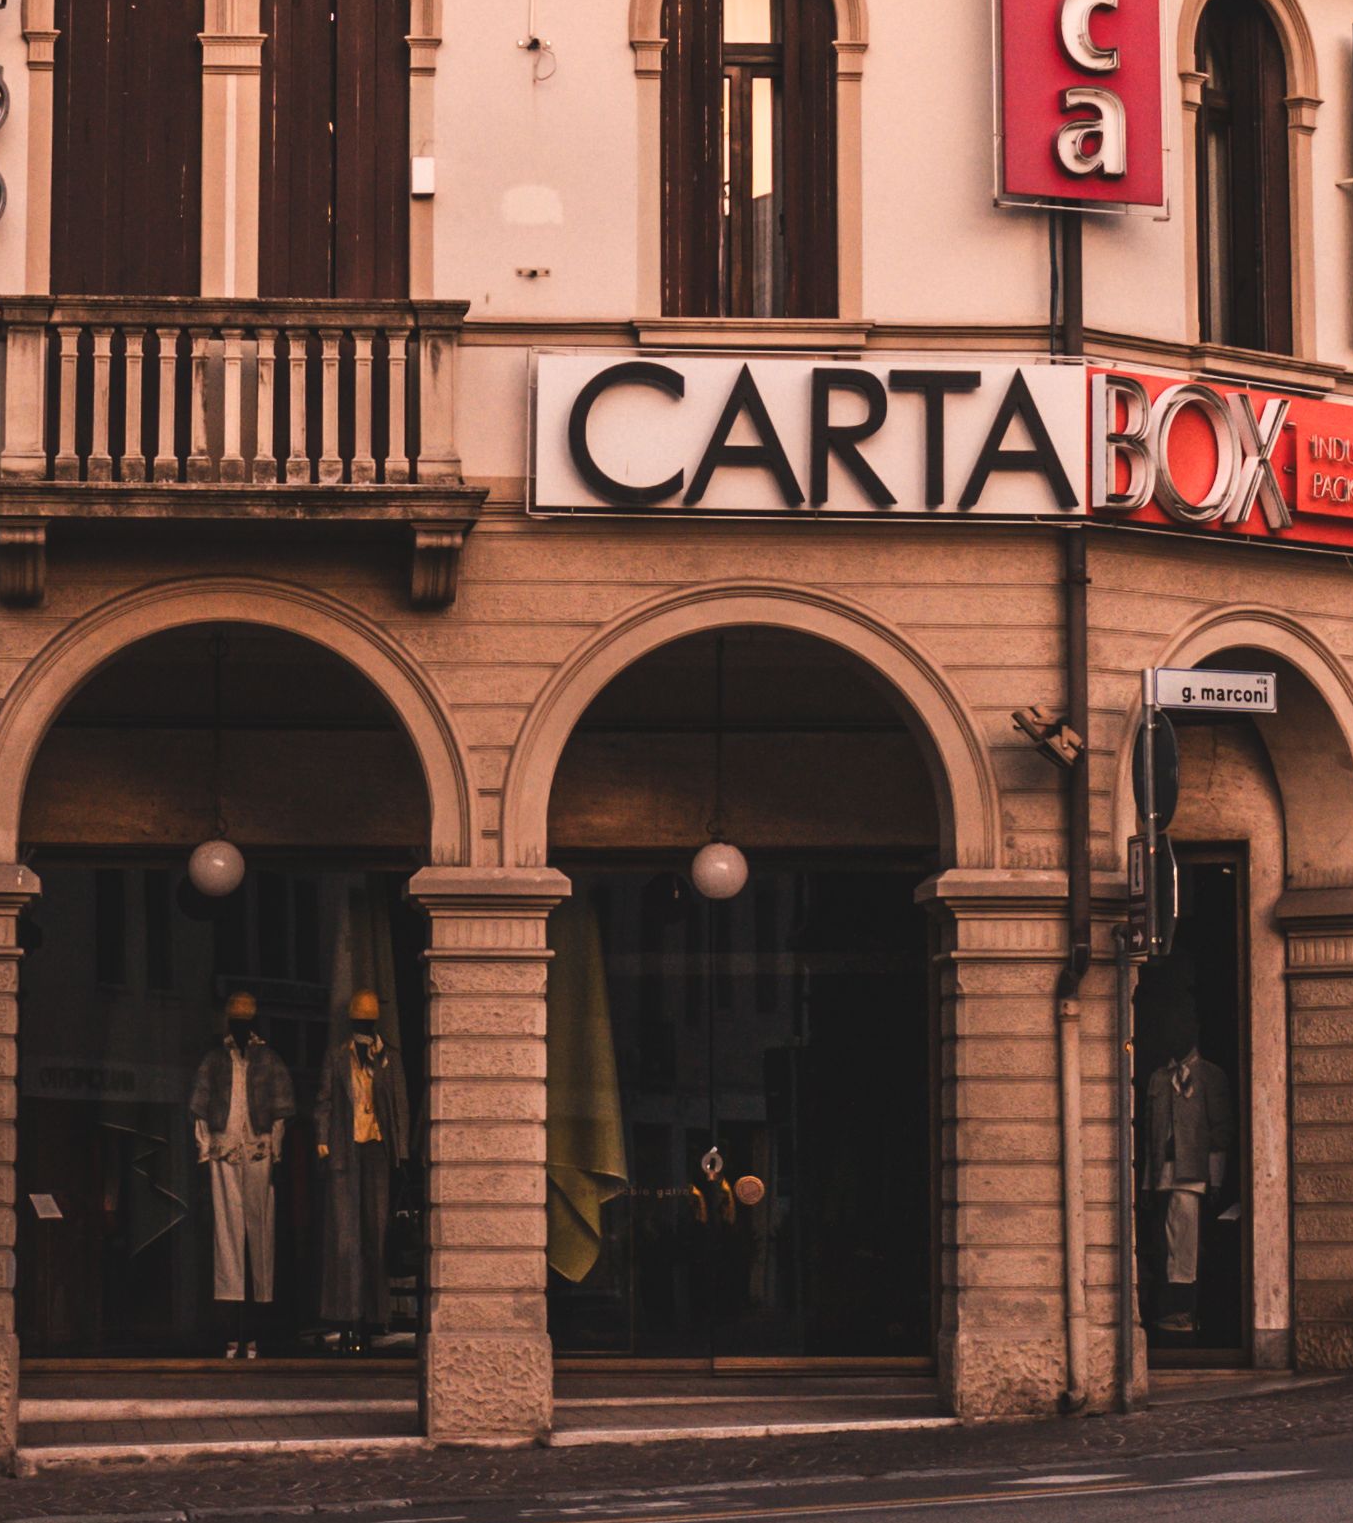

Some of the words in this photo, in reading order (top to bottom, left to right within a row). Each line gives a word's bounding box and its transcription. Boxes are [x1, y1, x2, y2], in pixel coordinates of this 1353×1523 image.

[568, 360, 1079, 509] CARTA
[1091, 373, 1294, 530] BOX
[1256, 677, 1268, 685] via
[1181, 685, 1197, 704] g.
[1200, 686, 1269, 704] marconi
